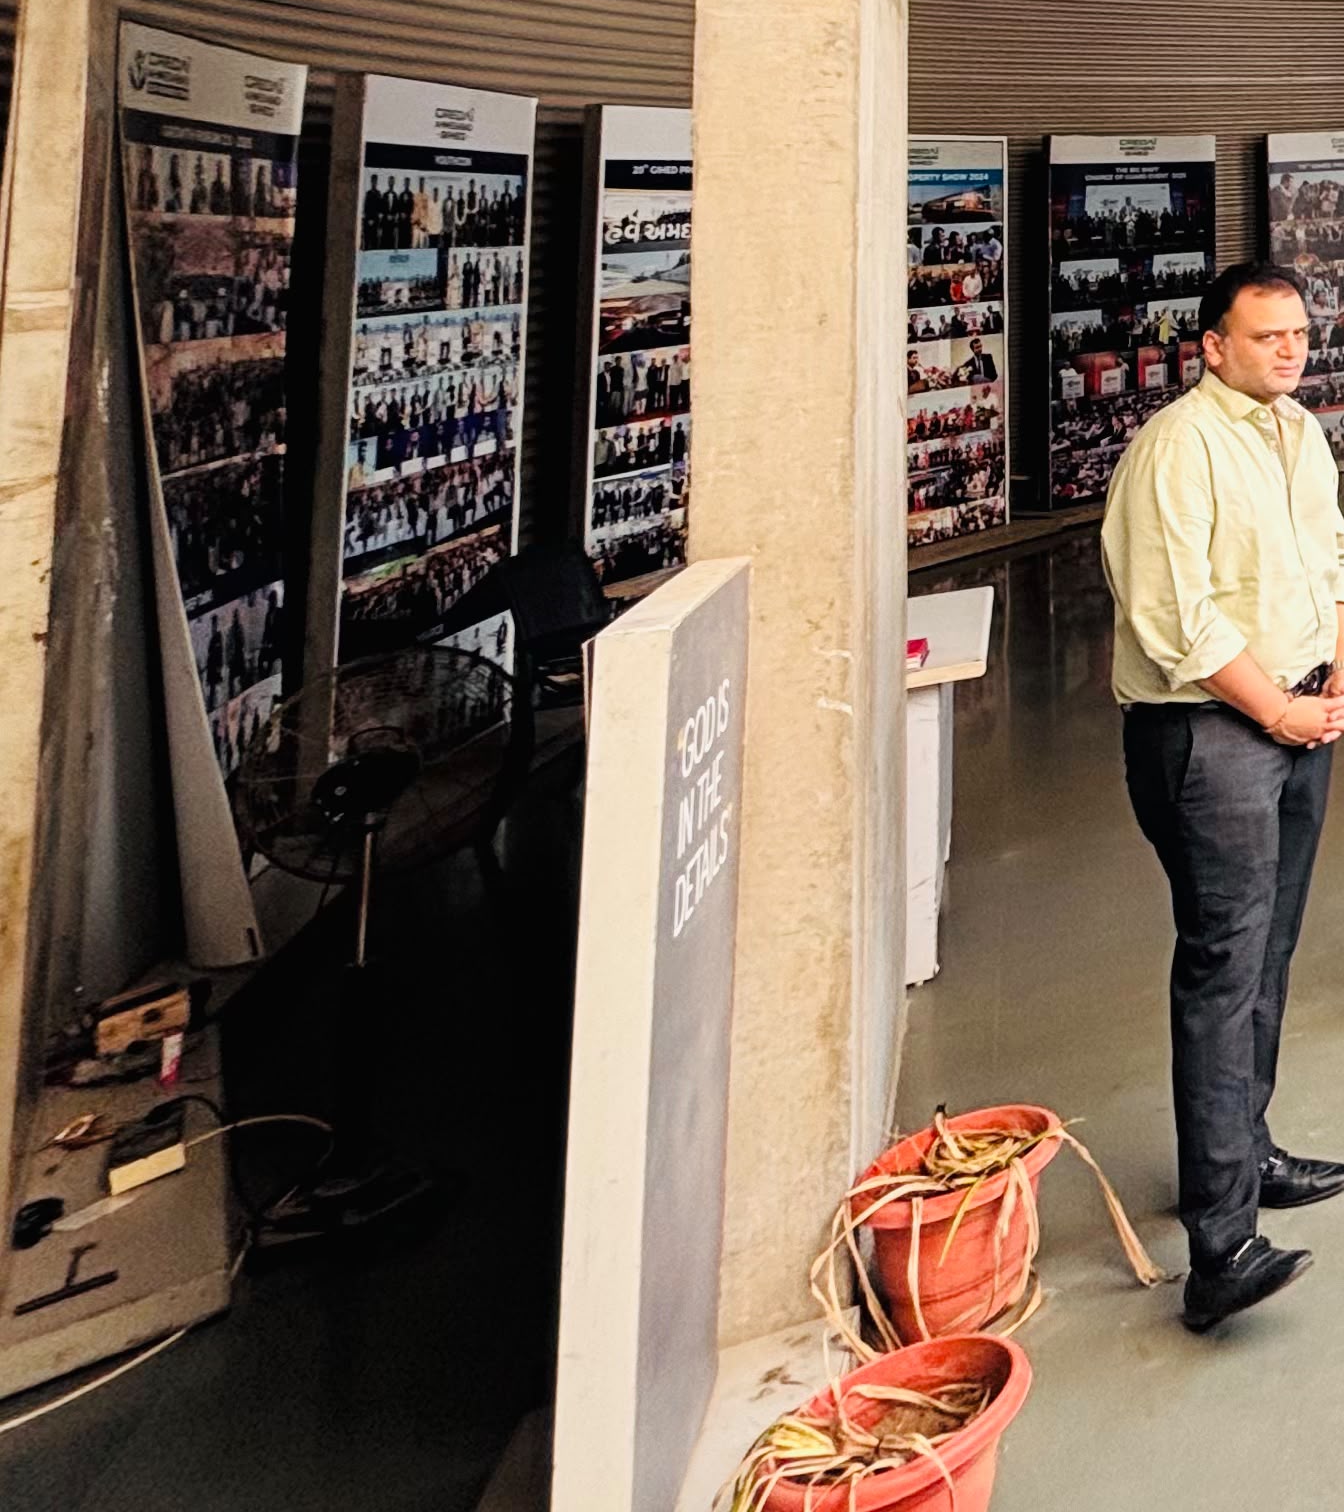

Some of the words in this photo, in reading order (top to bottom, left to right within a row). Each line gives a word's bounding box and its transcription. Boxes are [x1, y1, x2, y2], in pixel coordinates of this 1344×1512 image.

[717, 678, 730, 738] IS
[677, 787, 695, 859] IN
[697, 750, 724, 830] THE
